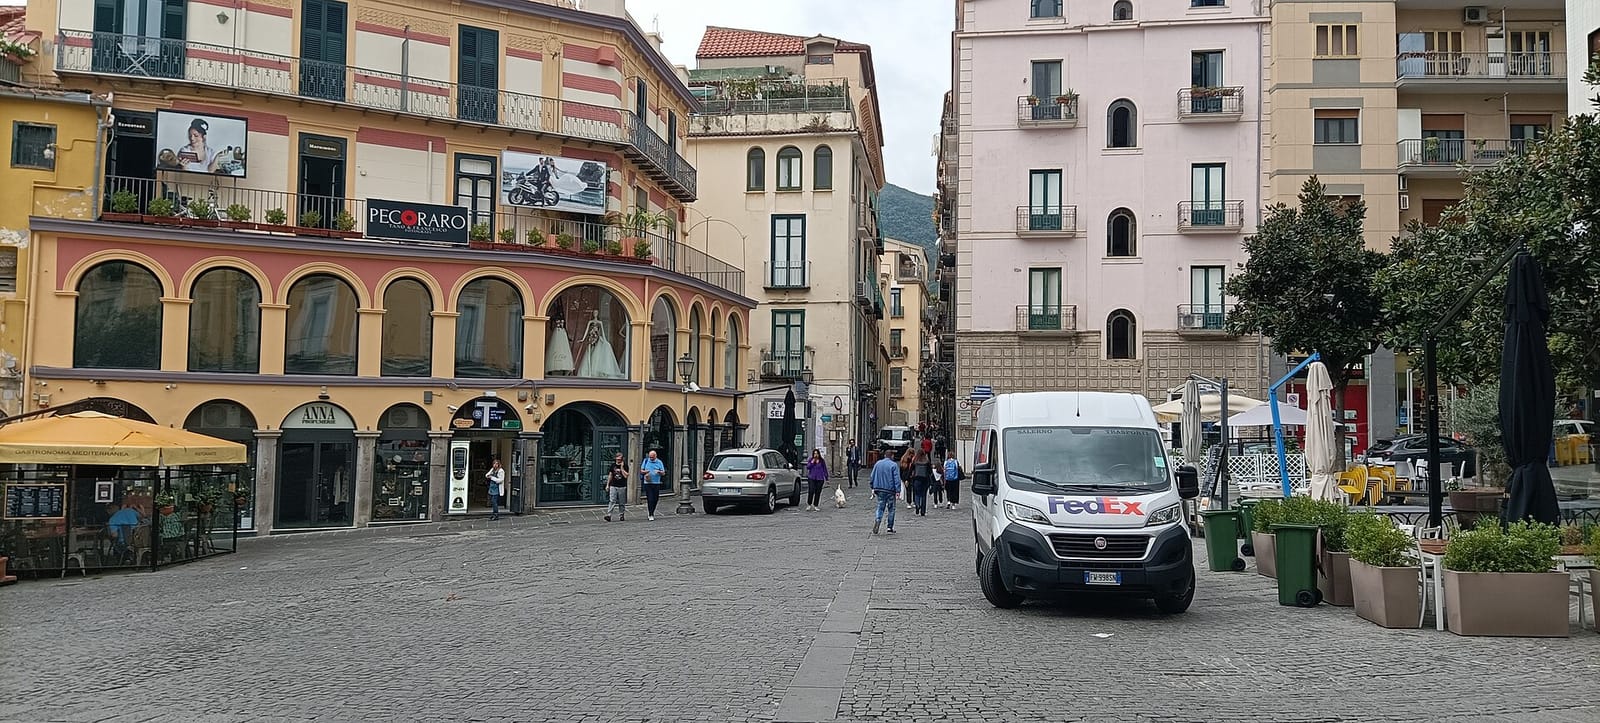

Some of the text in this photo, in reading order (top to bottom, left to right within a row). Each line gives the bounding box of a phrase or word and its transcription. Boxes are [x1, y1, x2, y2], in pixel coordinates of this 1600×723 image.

[369, 207, 466, 230] PECORARO
[413, 225, 448, 233] FRANCESCO
[302, 406, 336, 420] ANNA
[1047, 496, 1145, 516] FedEx
